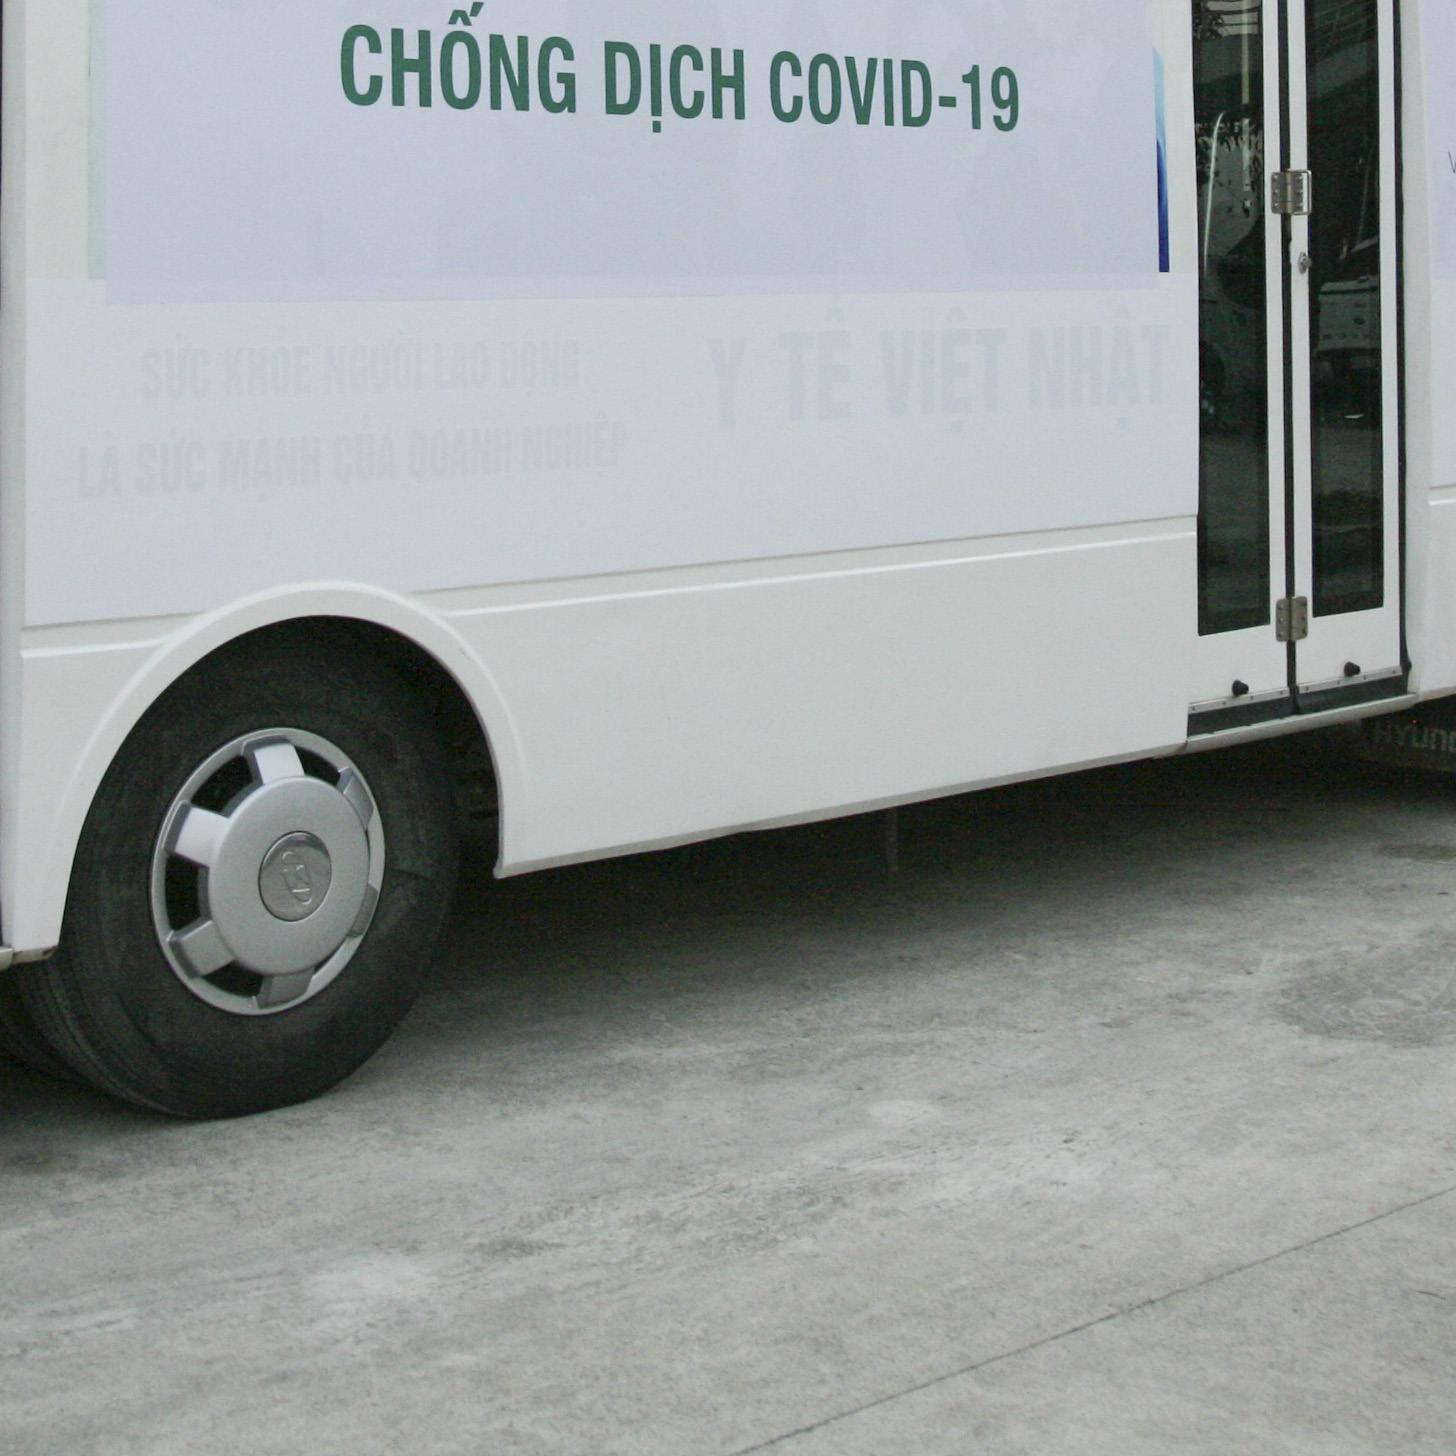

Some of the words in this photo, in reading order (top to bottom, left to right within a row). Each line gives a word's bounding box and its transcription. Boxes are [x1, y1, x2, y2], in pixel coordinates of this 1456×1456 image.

[340, 0, 577, 113] CHỐNG
[603, 40, 746, 133] DỊCH
[768, 49, 1020, 133] COVID-19
[706, 335, 747, 428] Y
[879, 305, 1007, 434] VIỆT
[1027, 303, 1171, 430] NHẬT
